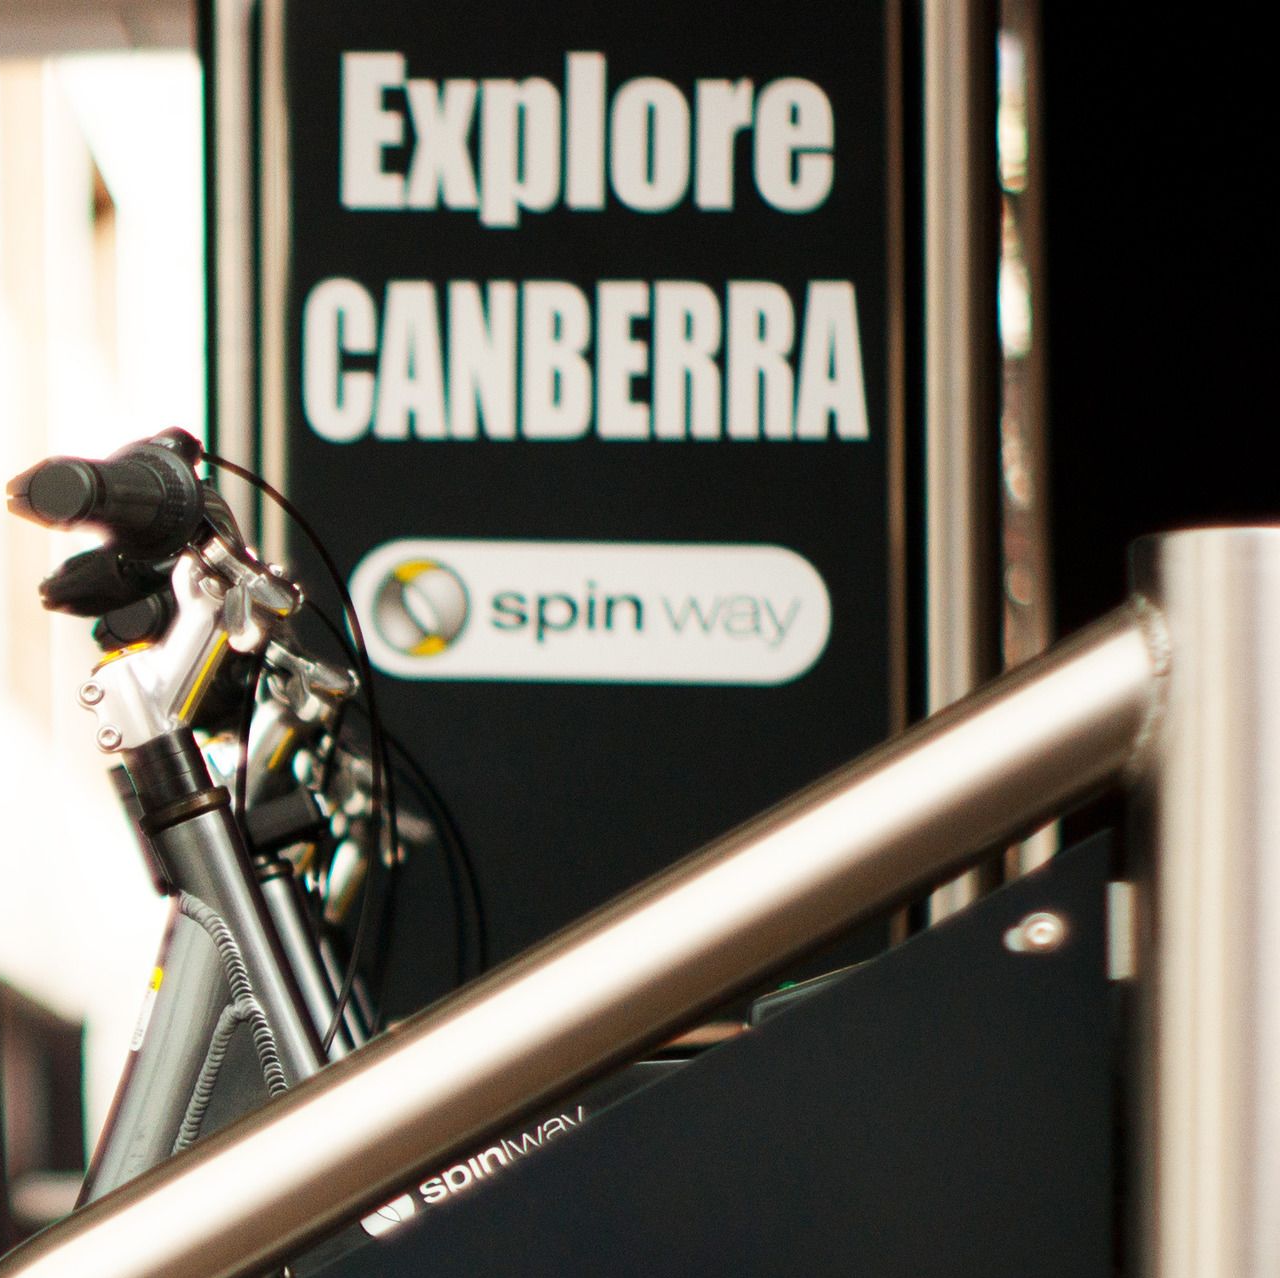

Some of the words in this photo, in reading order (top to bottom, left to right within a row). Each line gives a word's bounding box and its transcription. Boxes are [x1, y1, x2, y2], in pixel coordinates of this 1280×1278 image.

[340, 51, 835, 228] Explore
[302, 277, 869, 442] CANBERRA
[490, 576, 644, 641] spin
[662, 592, 802, 647] way
